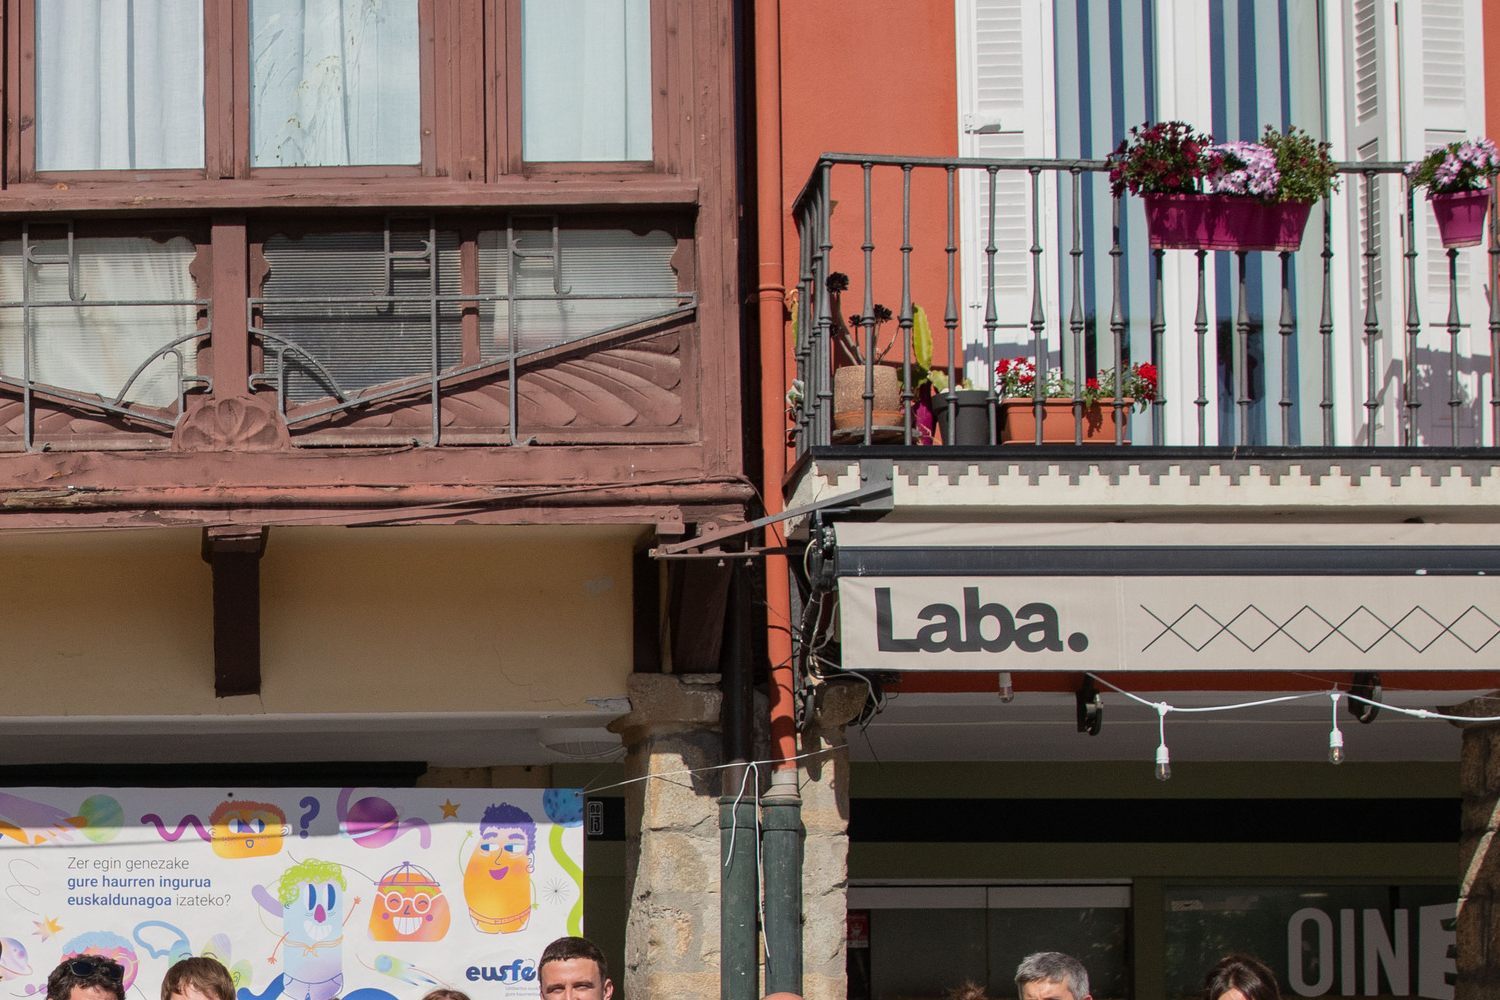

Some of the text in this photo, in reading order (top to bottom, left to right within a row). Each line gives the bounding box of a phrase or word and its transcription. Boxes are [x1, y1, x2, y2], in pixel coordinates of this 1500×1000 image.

[874, 586, 1090, 653] Laba.
[67, 857, 190, 872] Zer egin genezake
[67, 875, 211, 890] gure haurren ingurua
[67, 893, 232, 909] euskaldunagoa izateko?
[465, 958, 541, 984] eusfe
